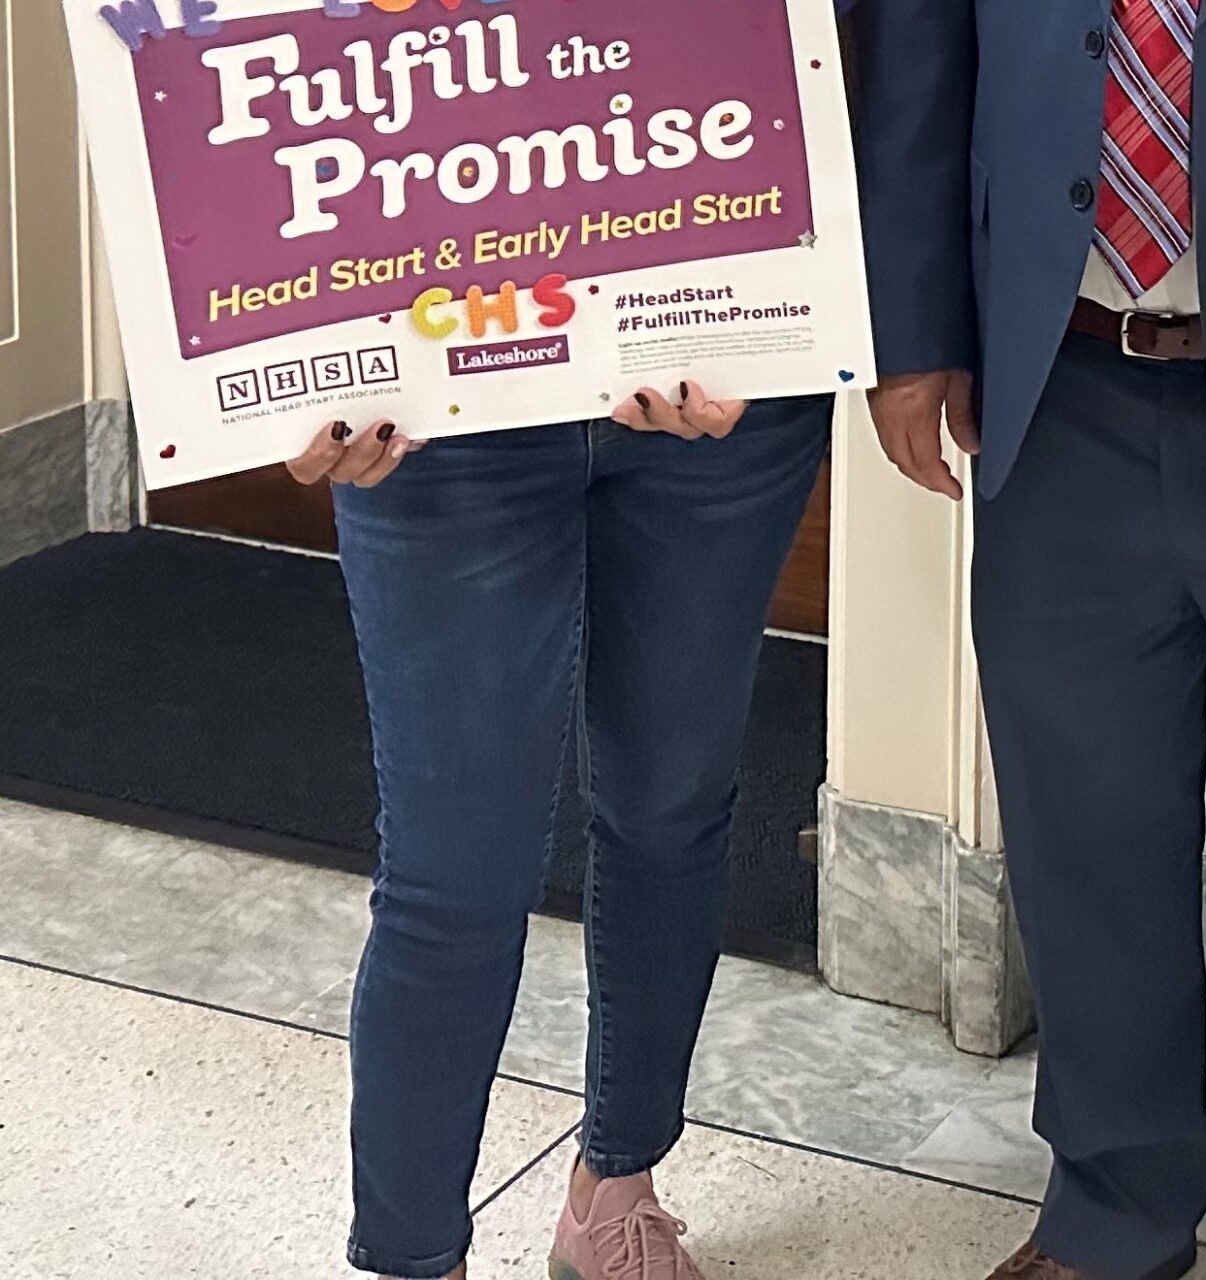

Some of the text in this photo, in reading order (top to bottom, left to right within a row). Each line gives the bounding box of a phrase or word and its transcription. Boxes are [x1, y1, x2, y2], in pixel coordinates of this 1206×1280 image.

[200, 13, 631, 146] Fulfill the
[272, 92, 755, 239] Promise
[208, 184, 783, 323] Head Start & Early Head Start
[410, 273, 577, 340] CHS
[615, 284, 735, 311] #HeadStart
[616, 301, 812, 333] #FulfillThePromise
[221, 385, 403, 426] NATIONAL HEAD START ASSOCIATION
[225, 354, 392, 403] NHSA
